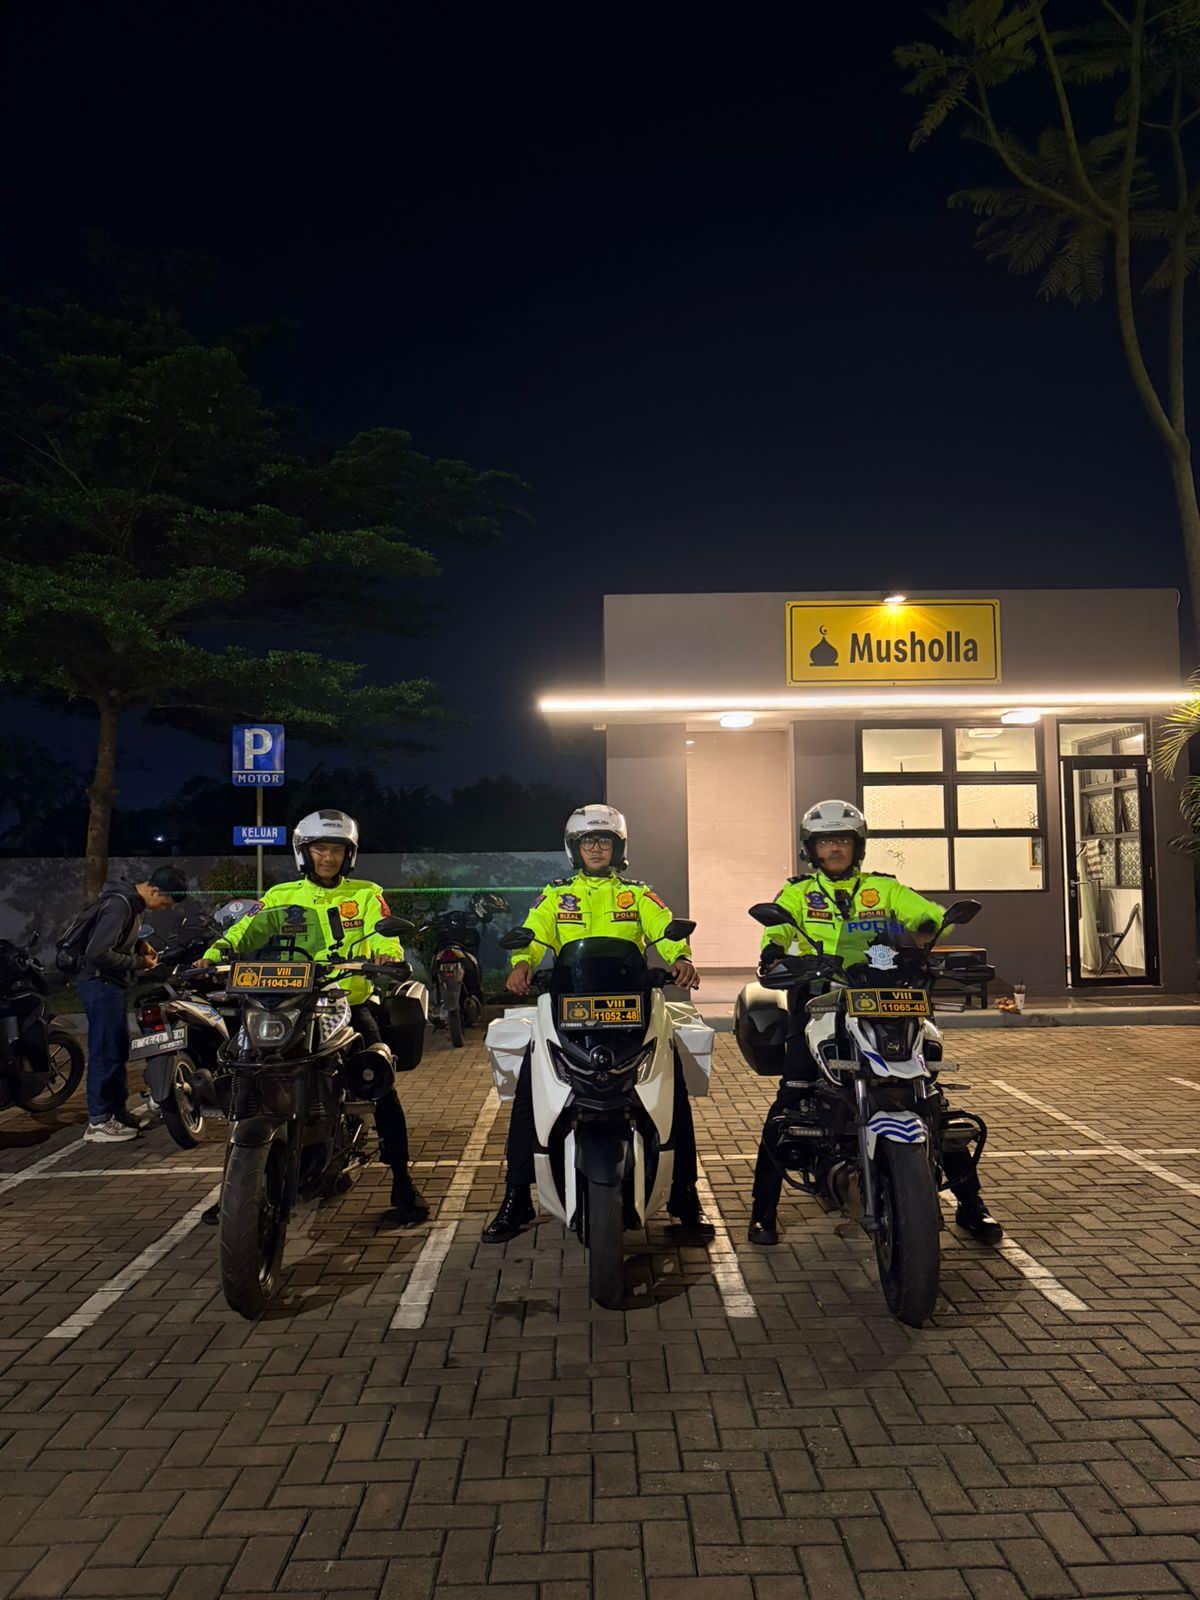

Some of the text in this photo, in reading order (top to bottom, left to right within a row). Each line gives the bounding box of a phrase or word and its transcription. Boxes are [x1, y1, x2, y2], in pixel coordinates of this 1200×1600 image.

[850, 631, 978, 663] Musholla
[244, 728, 273, 770] P
[238, 774, 279, 783] MOTOR
[241, 827, 278, 838] KELUAR
[277, 967, 291, 976] VIII
[892, 991, 912, 1000] VIII
[606, 1000, 625, 1008] VIII
